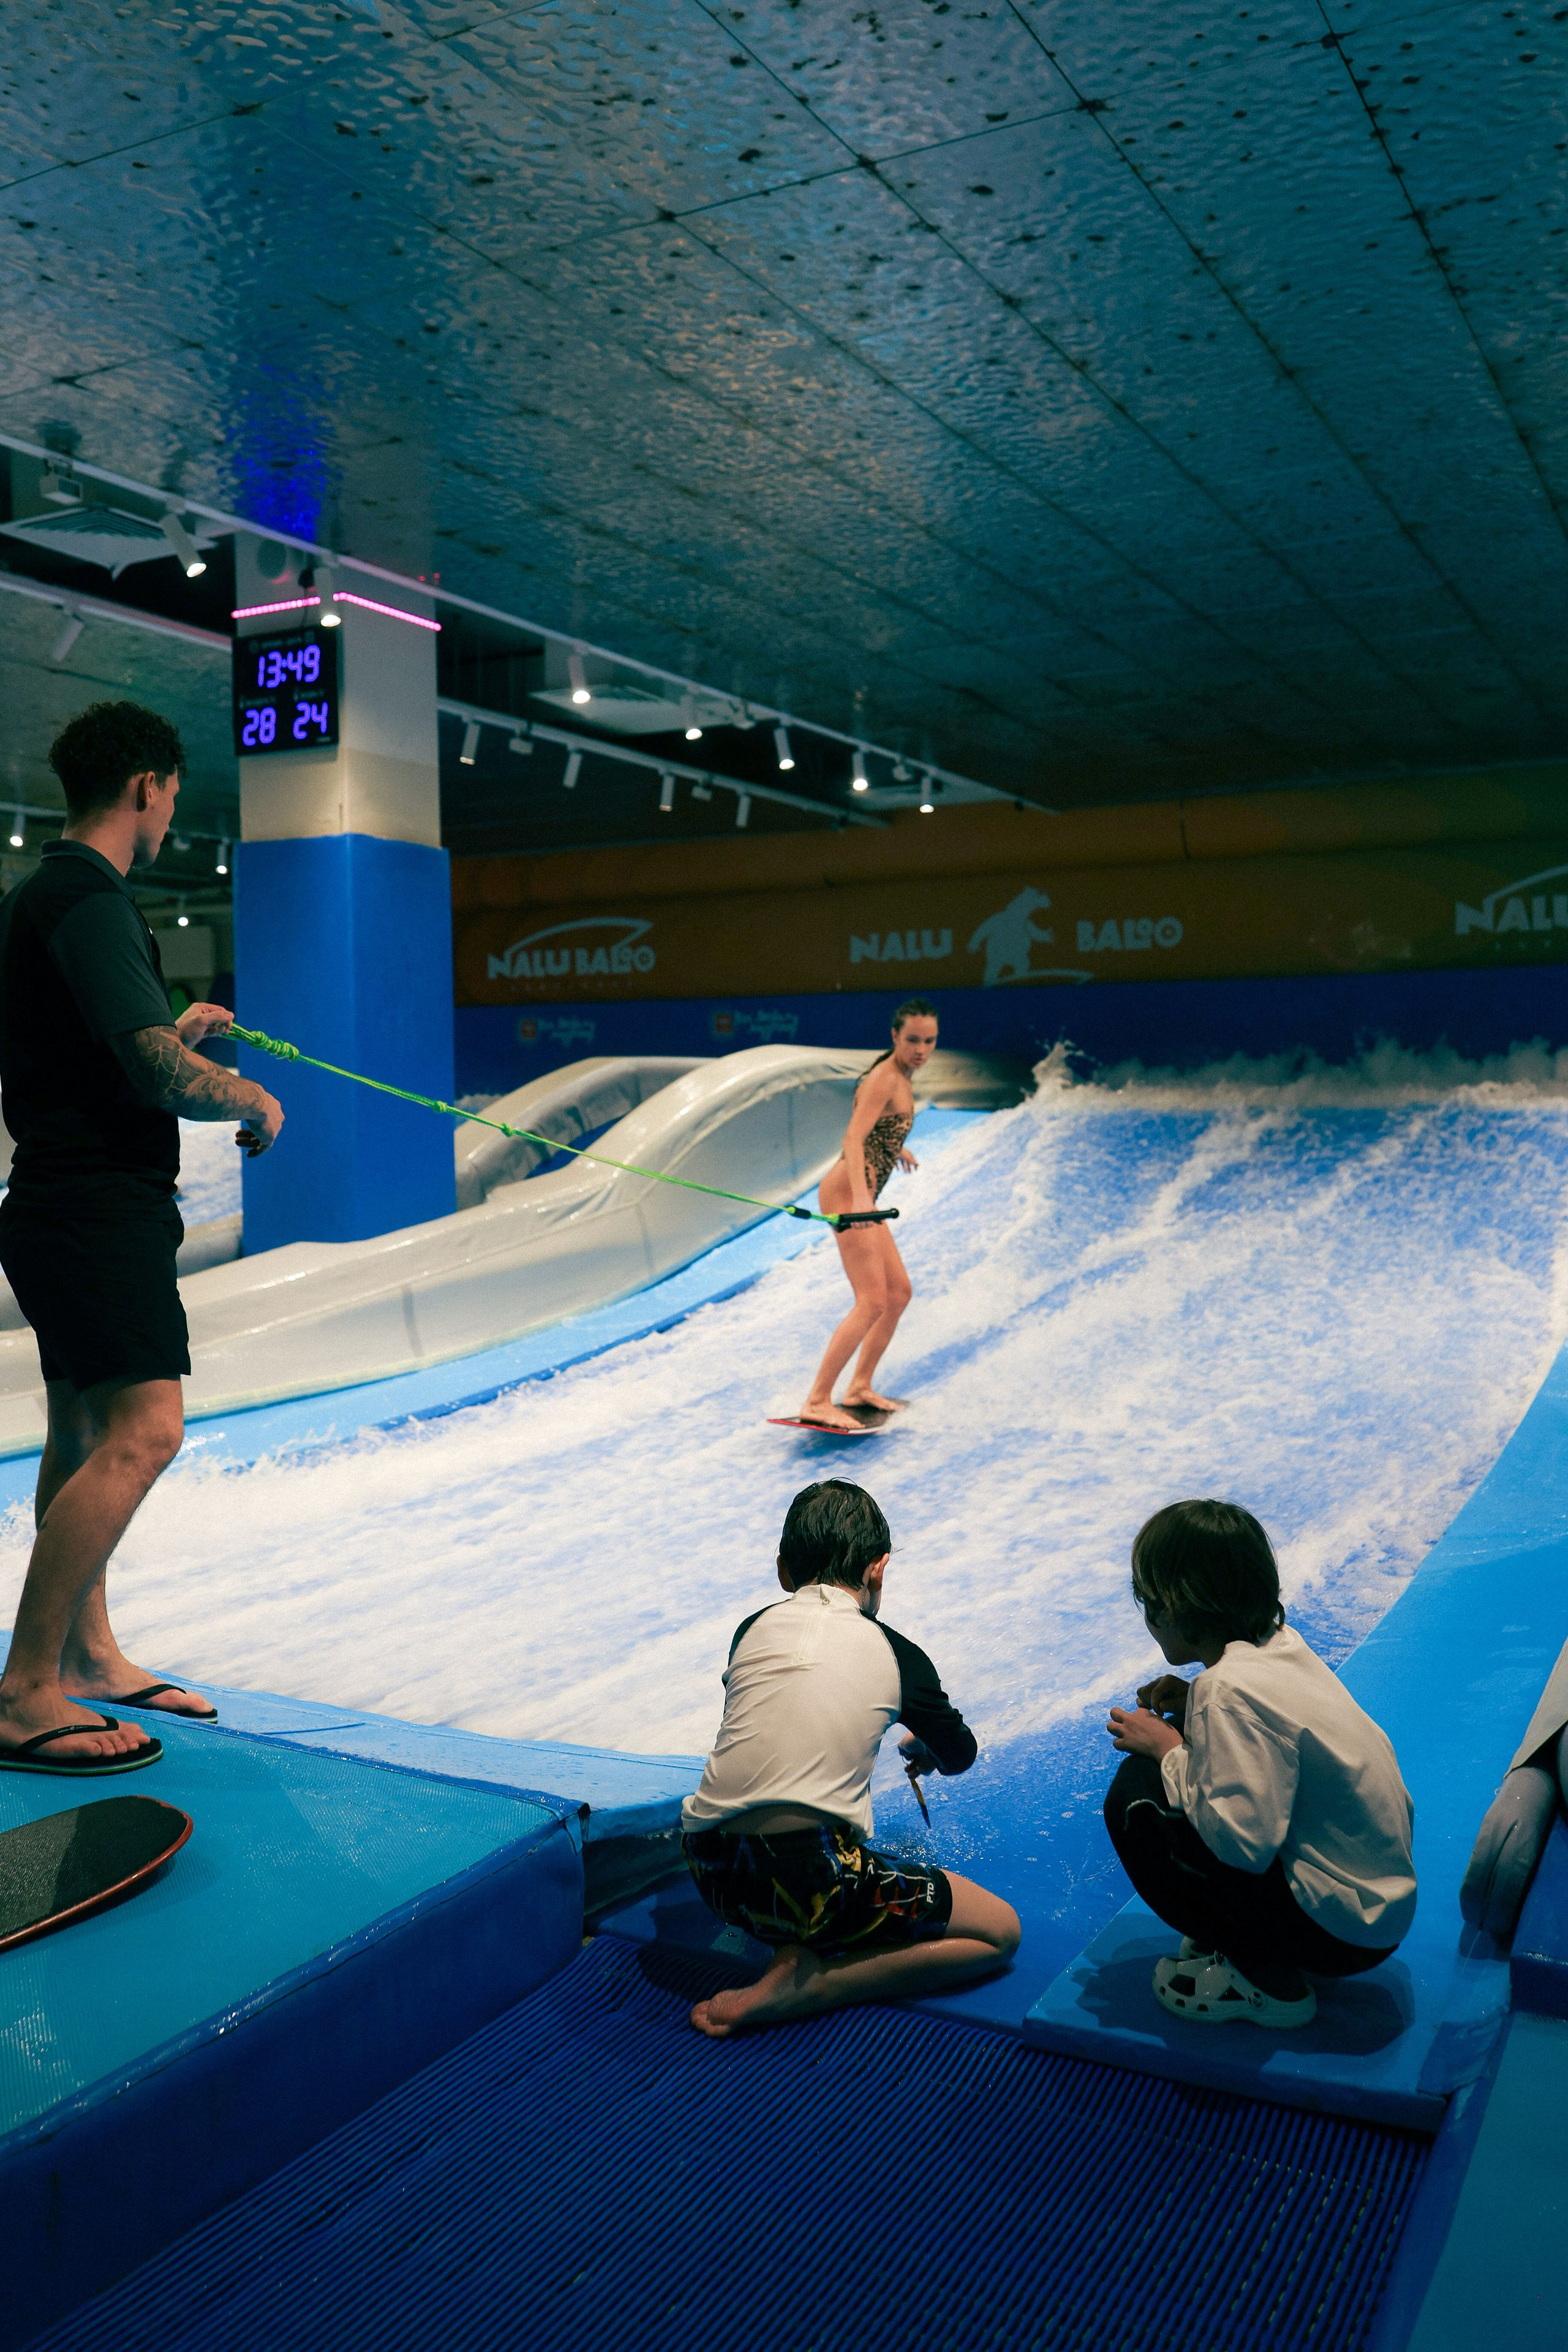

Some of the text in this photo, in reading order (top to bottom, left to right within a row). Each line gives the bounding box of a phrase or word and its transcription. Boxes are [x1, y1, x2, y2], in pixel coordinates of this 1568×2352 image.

[257, 644, 321, 688] 13:49
[242, 701, 328, 746] 28 24
[850, 916, 1184, 964] NALU BALOO
[487, 946, 571, 980] NALU
